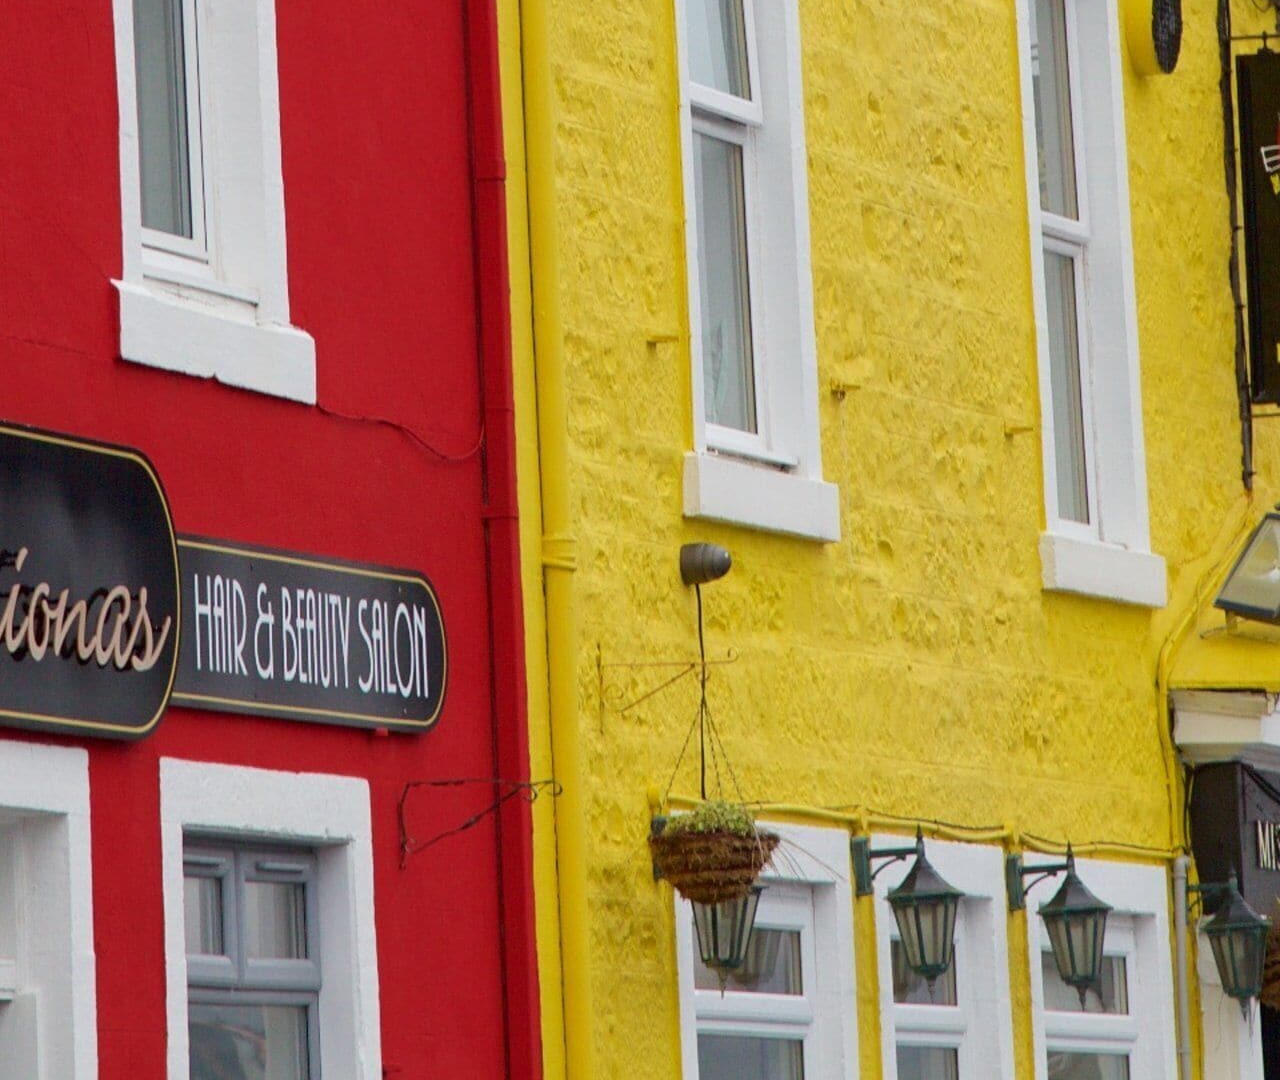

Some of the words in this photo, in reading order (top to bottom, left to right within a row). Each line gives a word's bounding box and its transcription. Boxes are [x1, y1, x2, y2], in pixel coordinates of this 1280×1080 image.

[194, 573, 249, 676] HAIR
[254, 582, 275, 680] &
[281, 586, 351, 689] BEAUTY
[358, 598, 429, 699] SALON
